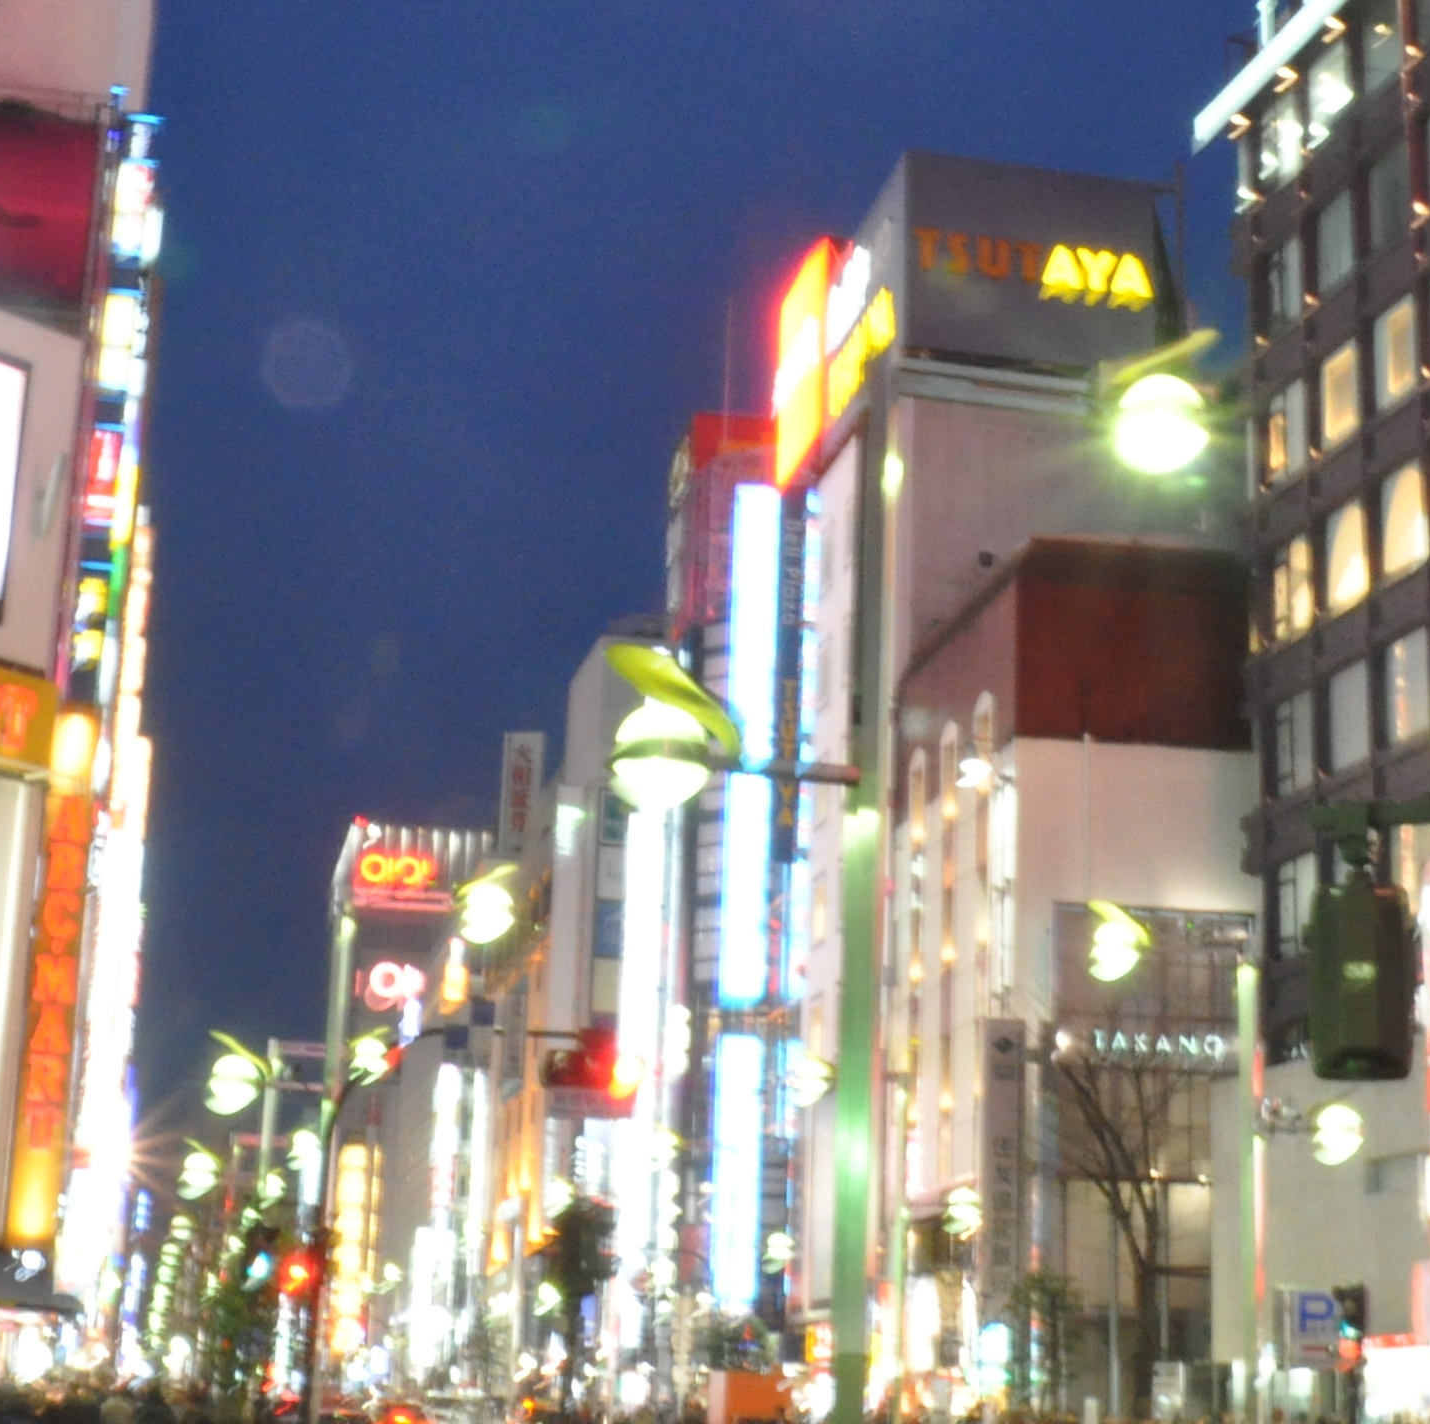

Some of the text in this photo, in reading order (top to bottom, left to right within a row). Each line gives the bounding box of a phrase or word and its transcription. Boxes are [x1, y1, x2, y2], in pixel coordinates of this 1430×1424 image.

[913, 227, 1155, 302] TSUTAYA
[778, 678, 800, 825] TSUTYA
[1094, 1028, 1229, 1062] TAKANO
